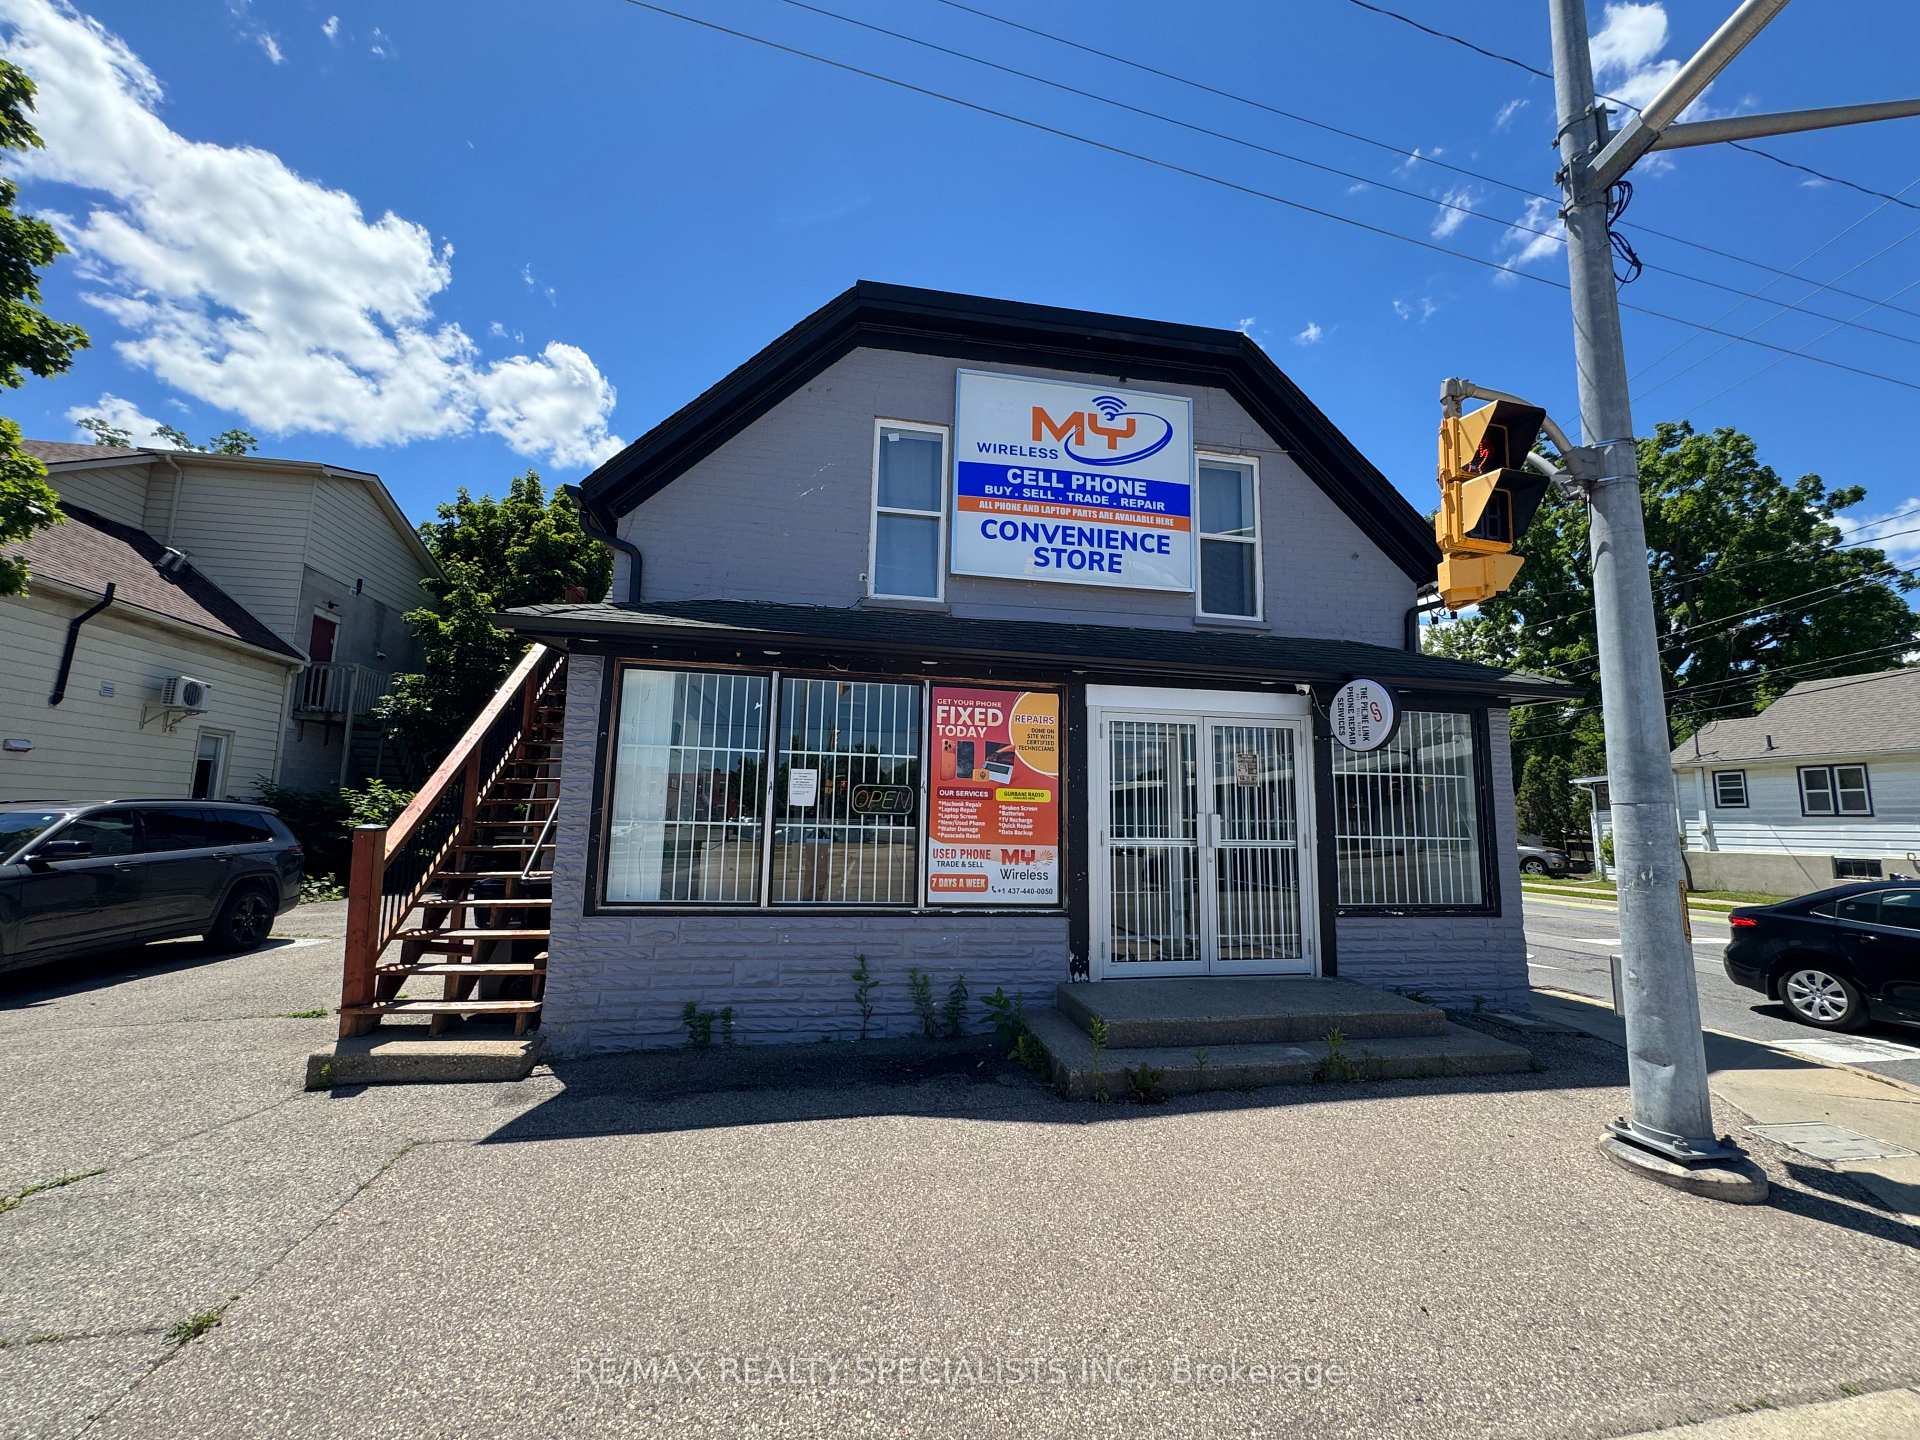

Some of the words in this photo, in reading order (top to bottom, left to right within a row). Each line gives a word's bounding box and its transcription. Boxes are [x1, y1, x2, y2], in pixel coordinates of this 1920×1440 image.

[1032, 406, 1136, 450] MY
[977, 442, 1058, 460] WIRELESS
[1007, 469, 1064, 489] CELL
[1072, 474, 1147, 496] PHONE
[985, 485, 1012, 495] BUY
[1023, 489, 1055, 500] SELL
[1066, 492, 1109, 504] TRADE
[1121, 497, 1165, 511] REPAIR
[979, 501, 993, 510] ALL
[995, 502, 1022, 511] PHONE
[1023, 504, 1039, 513] AND
[1041, 505, 1071, 515] LAPTOP
[1072, 508, 1097, 517] PARTS
[1098, 511, 1113, 519] ARE
[1115, 512, 1154, 524] AVAILABLE
[1156, 517, 1174, 526] HERE
[981, 519, 1170, 554] CONVENIENCE
[1034, 547, 1122, 573] STORE
[1347, 686, 1355, 714] PHONE
[1360, 687, 1368, 699] THE
[937, 706, 1003, 727] FIXED
[1015, 715, 1055, 724] REPAIRS
[937, 725, 987, 738] TODAY
[1348, 716, 1356, 745] REPAIR
[1362, 726, 1370, 741] LINK
[855, 790, 911, 810] OPEN
[933, 849, 956, 859] USED
[960, 849, 991, 859] PHONE
[1001, 849, 1035, 865] MY
[932, 878, 937, 886] 7
[939, 878, 956, 887] DAYS
[958, 878, 964, 887] A
[965, 878, 985, 888] WEEK
[1000, 868, 1048, 880] Wireless
